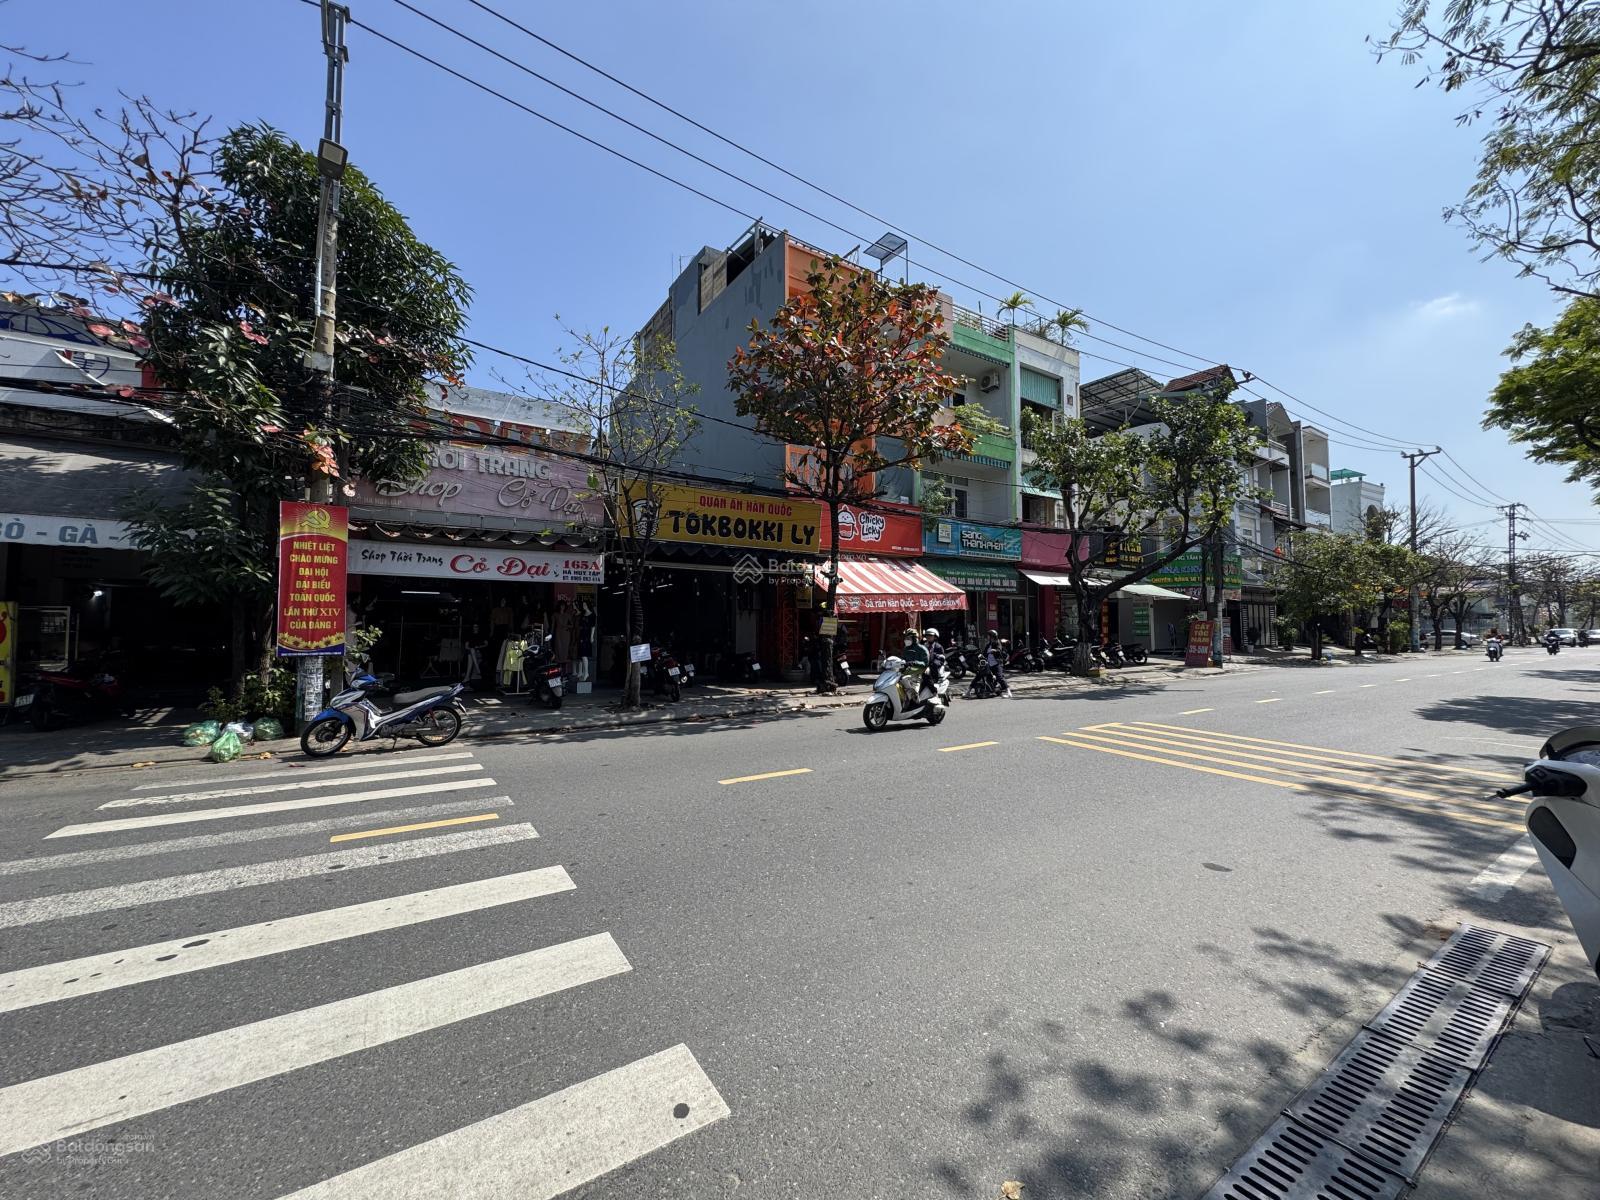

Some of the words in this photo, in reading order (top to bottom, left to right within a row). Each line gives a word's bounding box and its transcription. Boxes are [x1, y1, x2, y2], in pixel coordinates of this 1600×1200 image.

[476, 455, 552, 480] TRANG
[860, 512, 884, 529] Chicky
[0, 518, 26, 540] Ò
[58, 523, 99, 544] GÀ
[792, 524, 815, 545] LY
[862, 524, 880, 540] Licky
[293, 541, 317, 551] NHIỆT
[319, 542, 336, 553] LIỆT
[290, 554, 312, 562] CHÀO
[314, 554, 338, 564] MỪNG
[361, 549, 386, 564] Shop
[390, 550, 412, 562] Thời
[416, 552, 444, 566] Trang
[449, 554, 490, 574] Cỏ
[562, 560, 600, 570] 165A
[298, 568, 313, 578] ĐẠI
[315, 568, 328, 577] HỘI
[296, 580, 310, 590] ĐẠI
[312, 578, 330, 589] BIỂU
[290, 592, 312, 602] TOÀN
[314, 592, 336, 602] QUỐC
[865, 598, 874, 608] Gà
[875, 599, 887, 607] rán
[284, 606, 300, 616] LẦN
[302, 607, 318, 616] THỨ
[320, 608, 340, 616] XIV
[290, 620, 306, 629] CỦA
[308, 620, 332, 629] ĐẢNG
